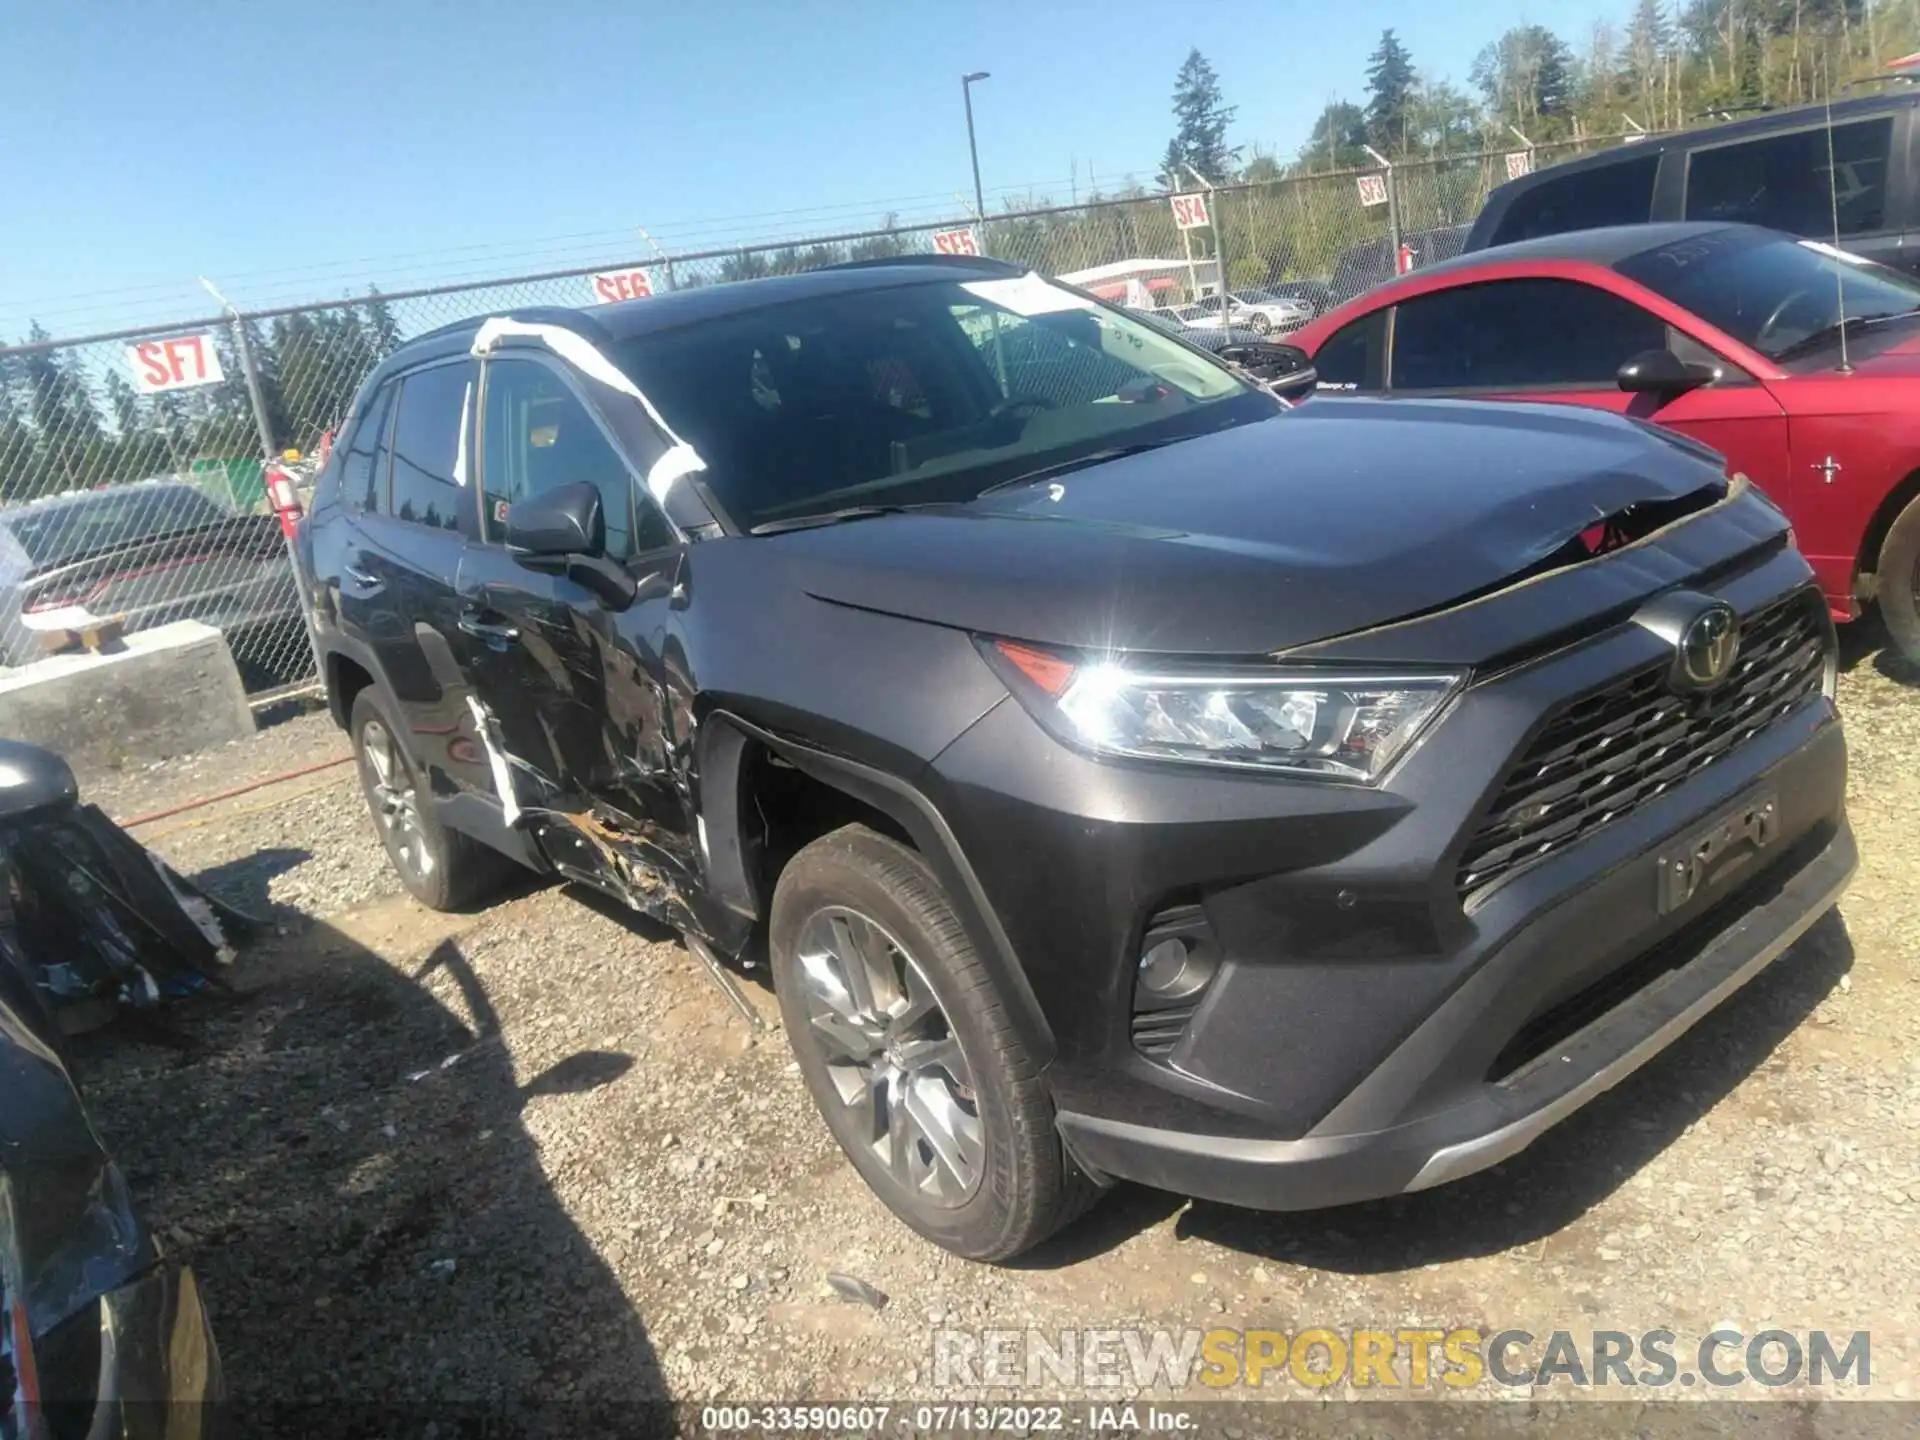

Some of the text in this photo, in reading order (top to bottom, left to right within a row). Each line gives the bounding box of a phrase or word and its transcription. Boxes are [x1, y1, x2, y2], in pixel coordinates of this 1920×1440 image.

[1359, 179, 1385, 202] SF3
[1174, 198, 1205, 225] SF4
[935, 230, 976, 254] SF5
[596, 272, 652, 302] SF6
[136, 336, 206, 386] SF7
